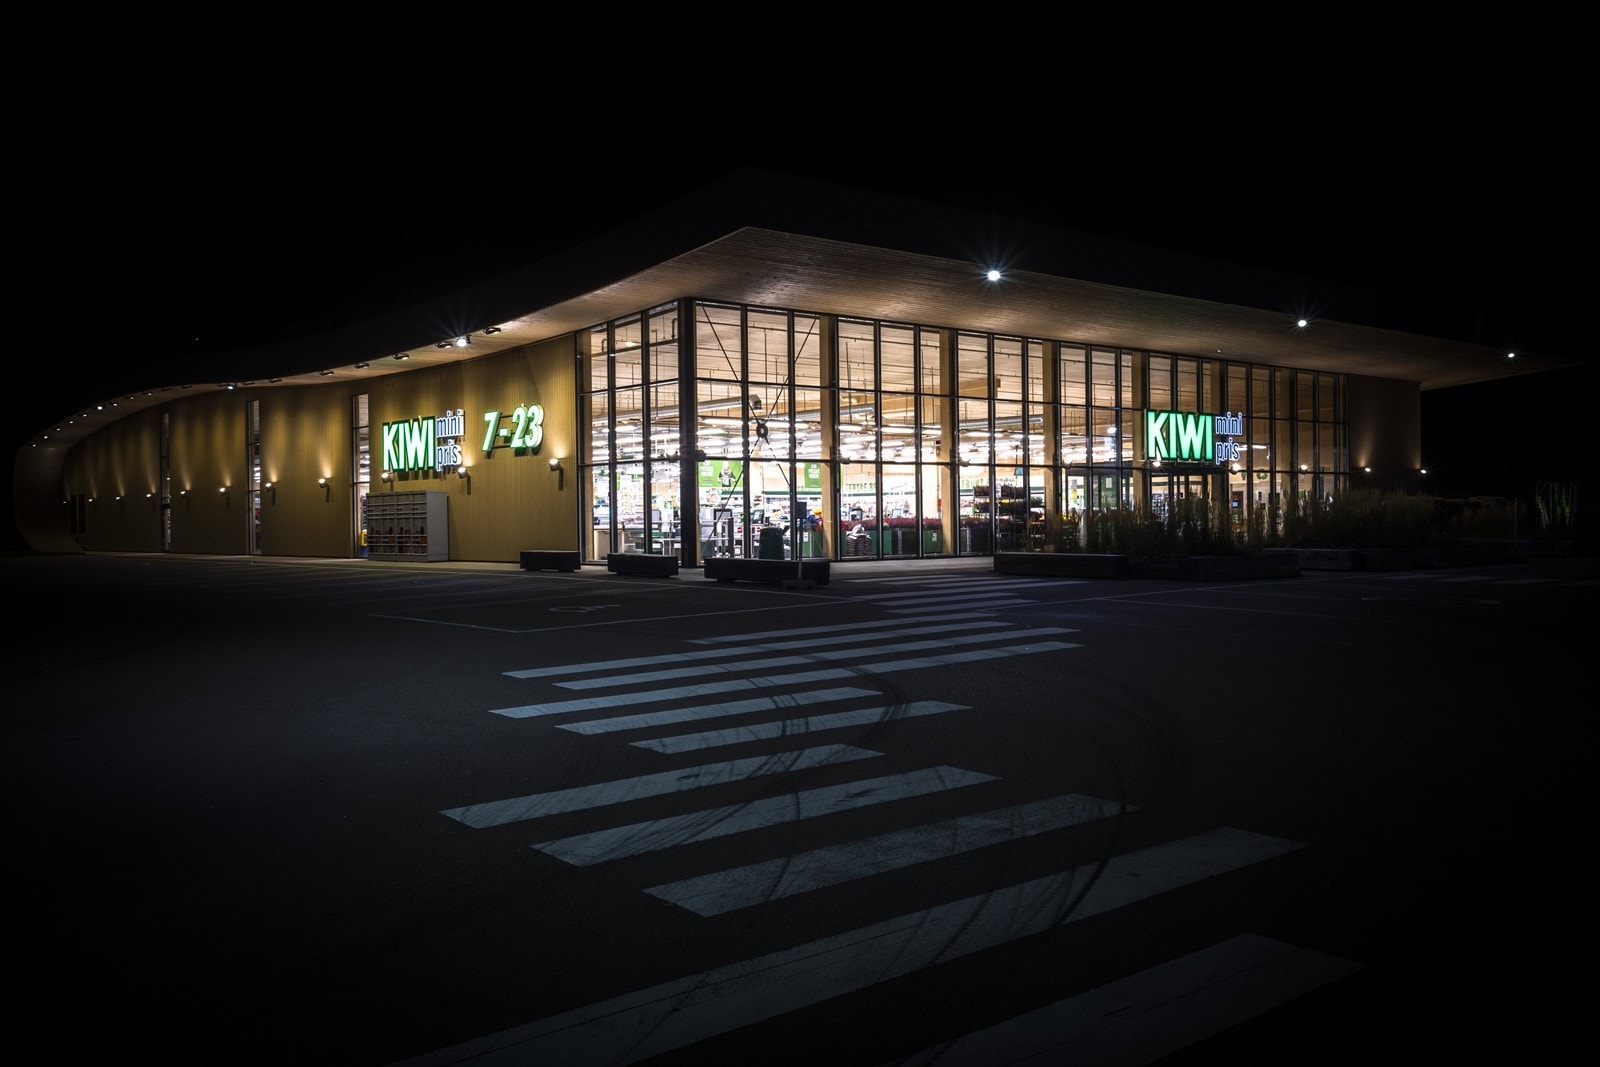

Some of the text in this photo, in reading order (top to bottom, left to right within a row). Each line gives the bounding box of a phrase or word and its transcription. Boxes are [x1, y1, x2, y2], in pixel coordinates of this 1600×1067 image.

[435, 409, 465, 438] mini
[481, 403, 544, 452] 7-23
[1147, 409, 1214, 462] KIWI
[1214, 411, 1243, 436] mini
[382, 416, 436, 472] KIWI
[435, 439, 463, 472] pris
[1214, 437, 1241, 465] pris
